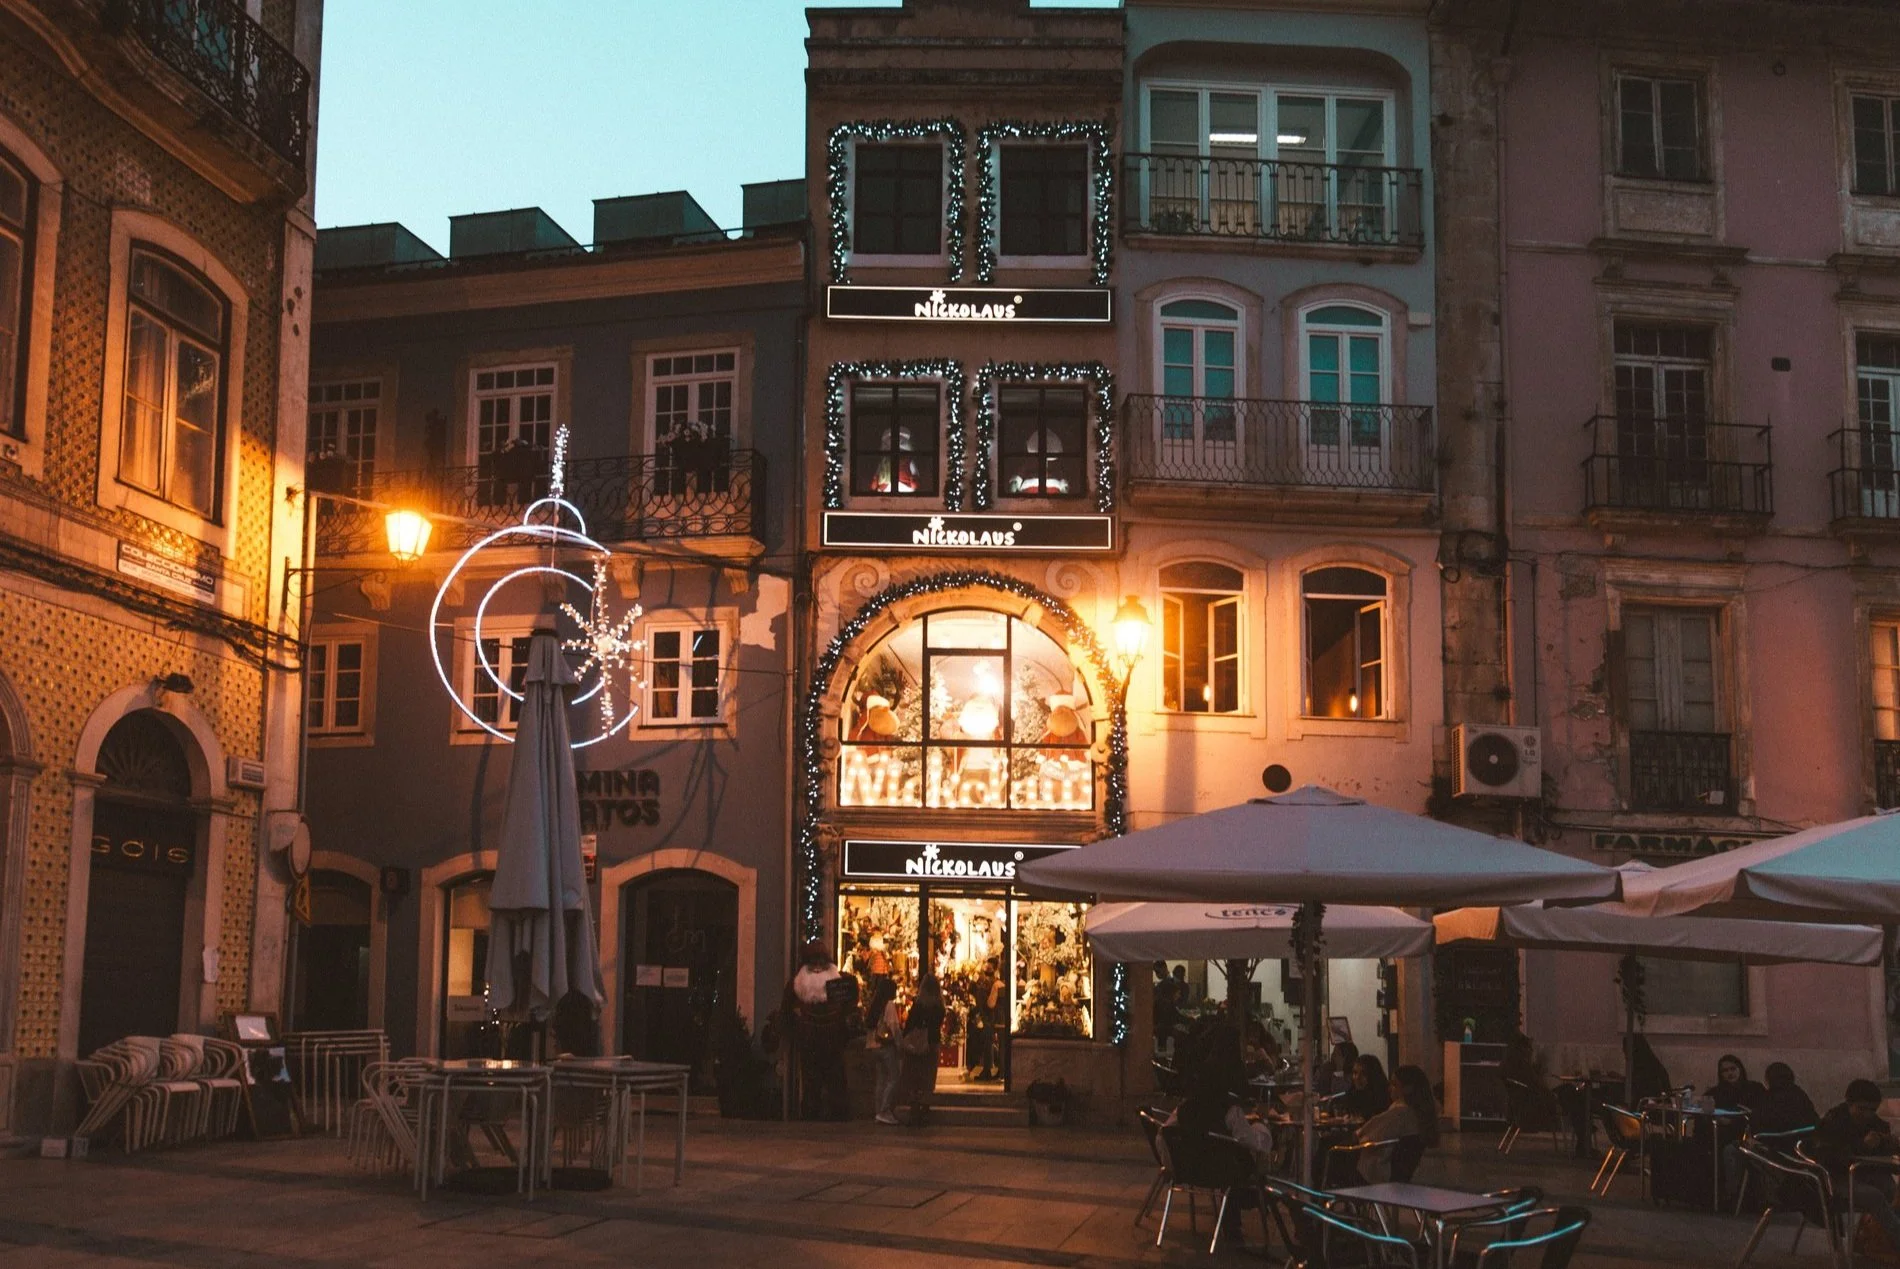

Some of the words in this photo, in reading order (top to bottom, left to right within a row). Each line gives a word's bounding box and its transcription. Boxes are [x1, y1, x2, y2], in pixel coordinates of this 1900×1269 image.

[914, 289, 1016, 319] NICKOLAUS
[912, 516, 1015, 546] NICKOLAUS
[905, 844, 1016, 878] NICKOLAUS
